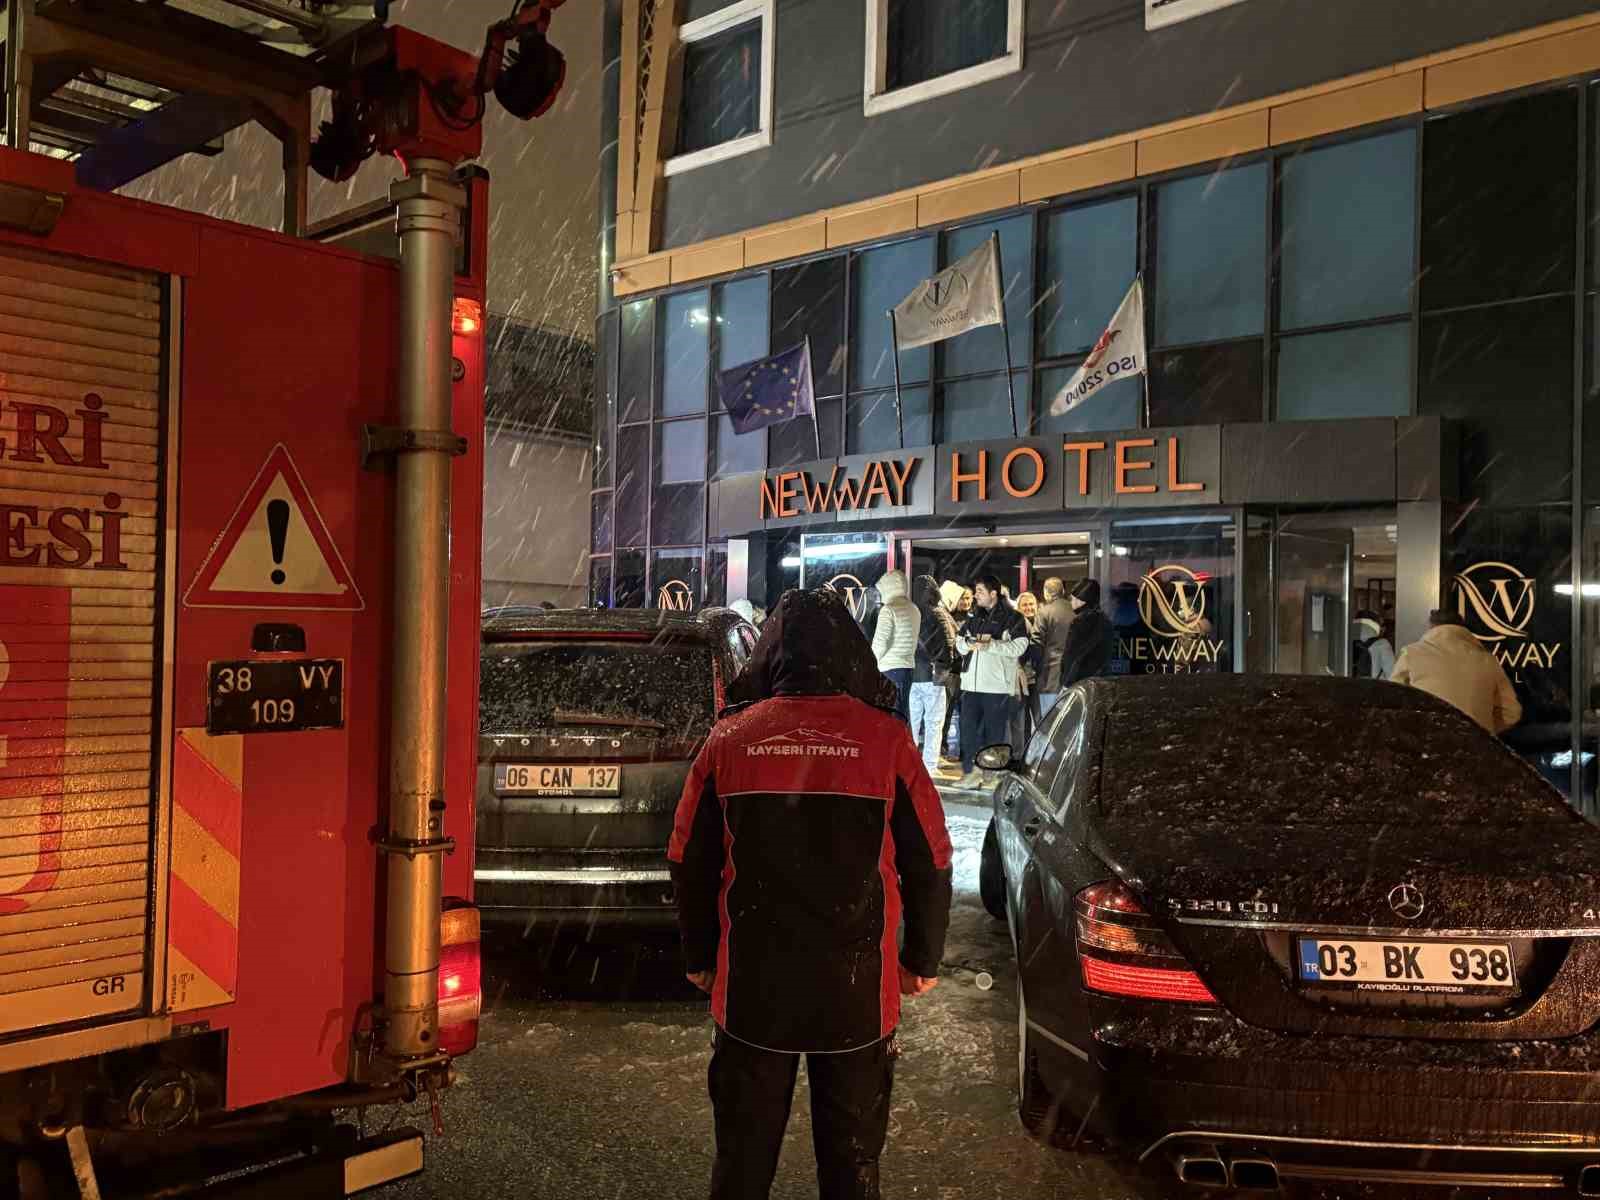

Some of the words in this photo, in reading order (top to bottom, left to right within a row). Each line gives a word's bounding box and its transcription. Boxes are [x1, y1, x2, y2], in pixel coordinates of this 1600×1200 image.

[0, 392, 110, 470] Rİ
[951, 436, 1206, 503] HOTEL
[217, 666, 252, 693] 38
[299, 666, 334, 689] VY
[251, 698, 296, 723] 109
[493, 738, 621, 748] VOLVO
[507, 767, 529, 788] 06
[540, 767, 573, 788] CAN
[587, 767, 617, 788] 137
[1185, 899, 1232, 913] 320
[1238, 902, 1279, 914] CDI
[1303, 962, 1319, 974] TR
[1318, 944, 1357, 977] 03
[1383, 945, 1425, 979] BK
[1450, 947, 1510, 982] 938
[92, 975, 125, 997] GR
